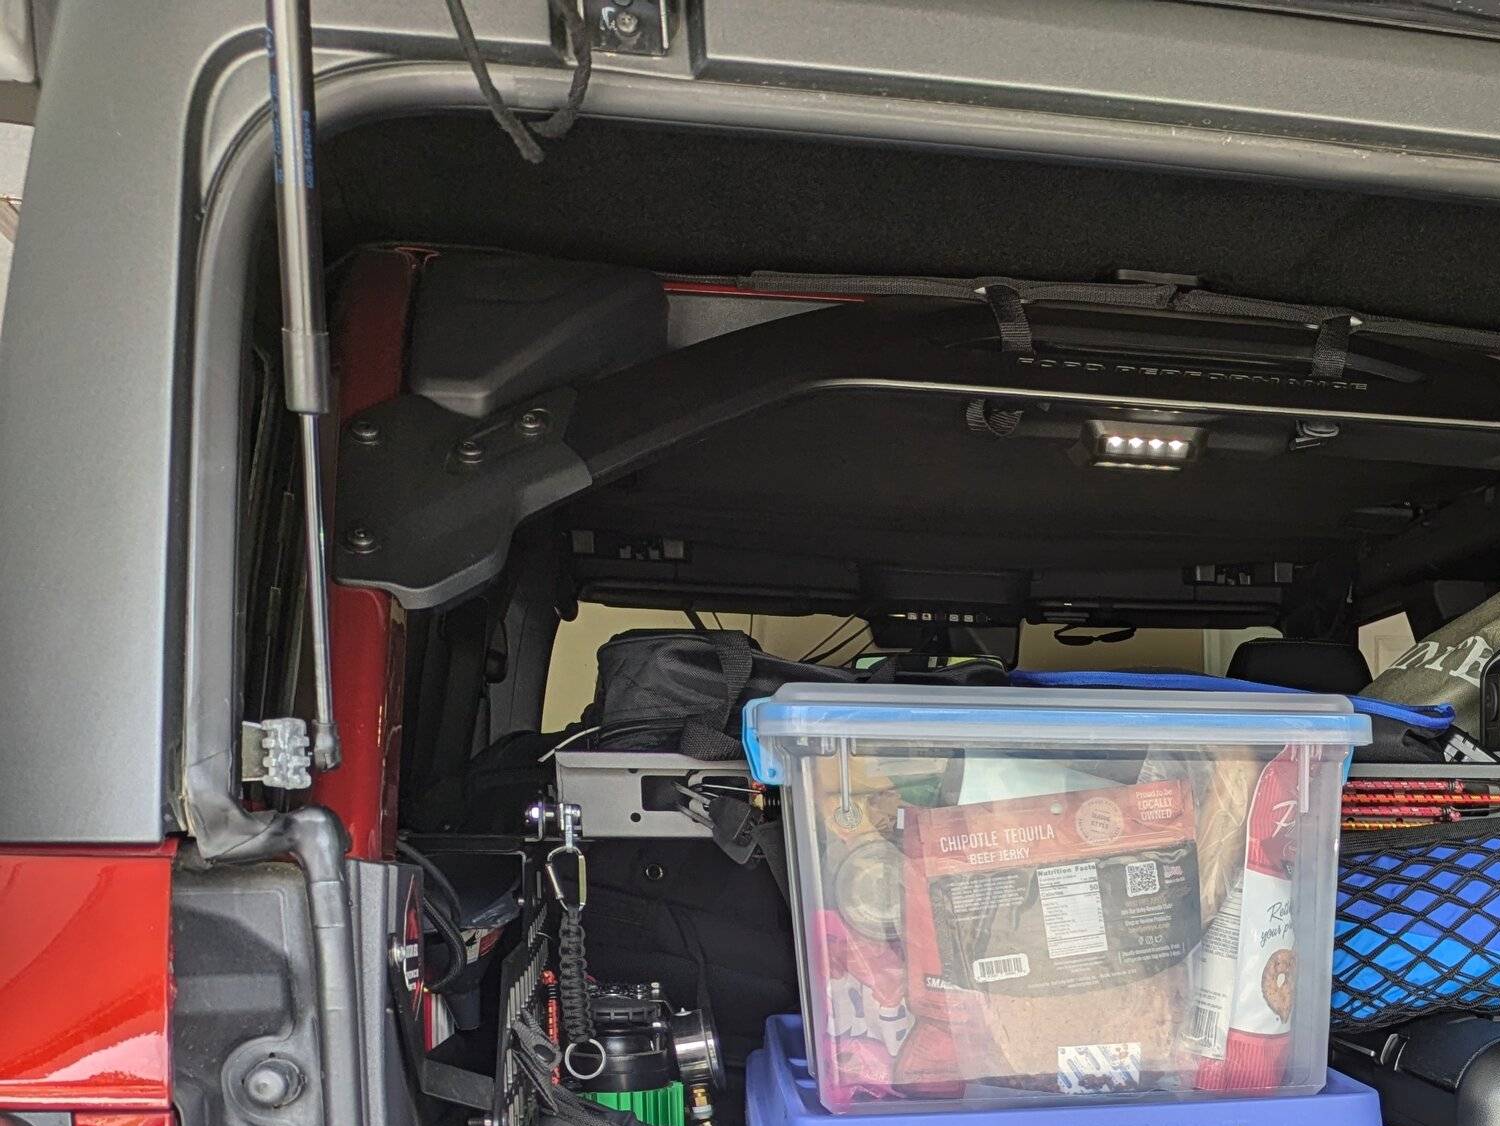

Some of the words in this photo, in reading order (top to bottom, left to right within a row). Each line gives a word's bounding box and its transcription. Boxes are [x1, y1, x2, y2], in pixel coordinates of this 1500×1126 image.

[1137, 797, 1174, 811] LOCALLY
[1140, 808, 1172, 821] OWNED
[940, 830, 998, 853] CHIPOTLE
[1004, 823, 1055, 845] TEQUILA
[968, 850, 998, 865] BEEF
[999, 847, 1030, 863] JERKY
